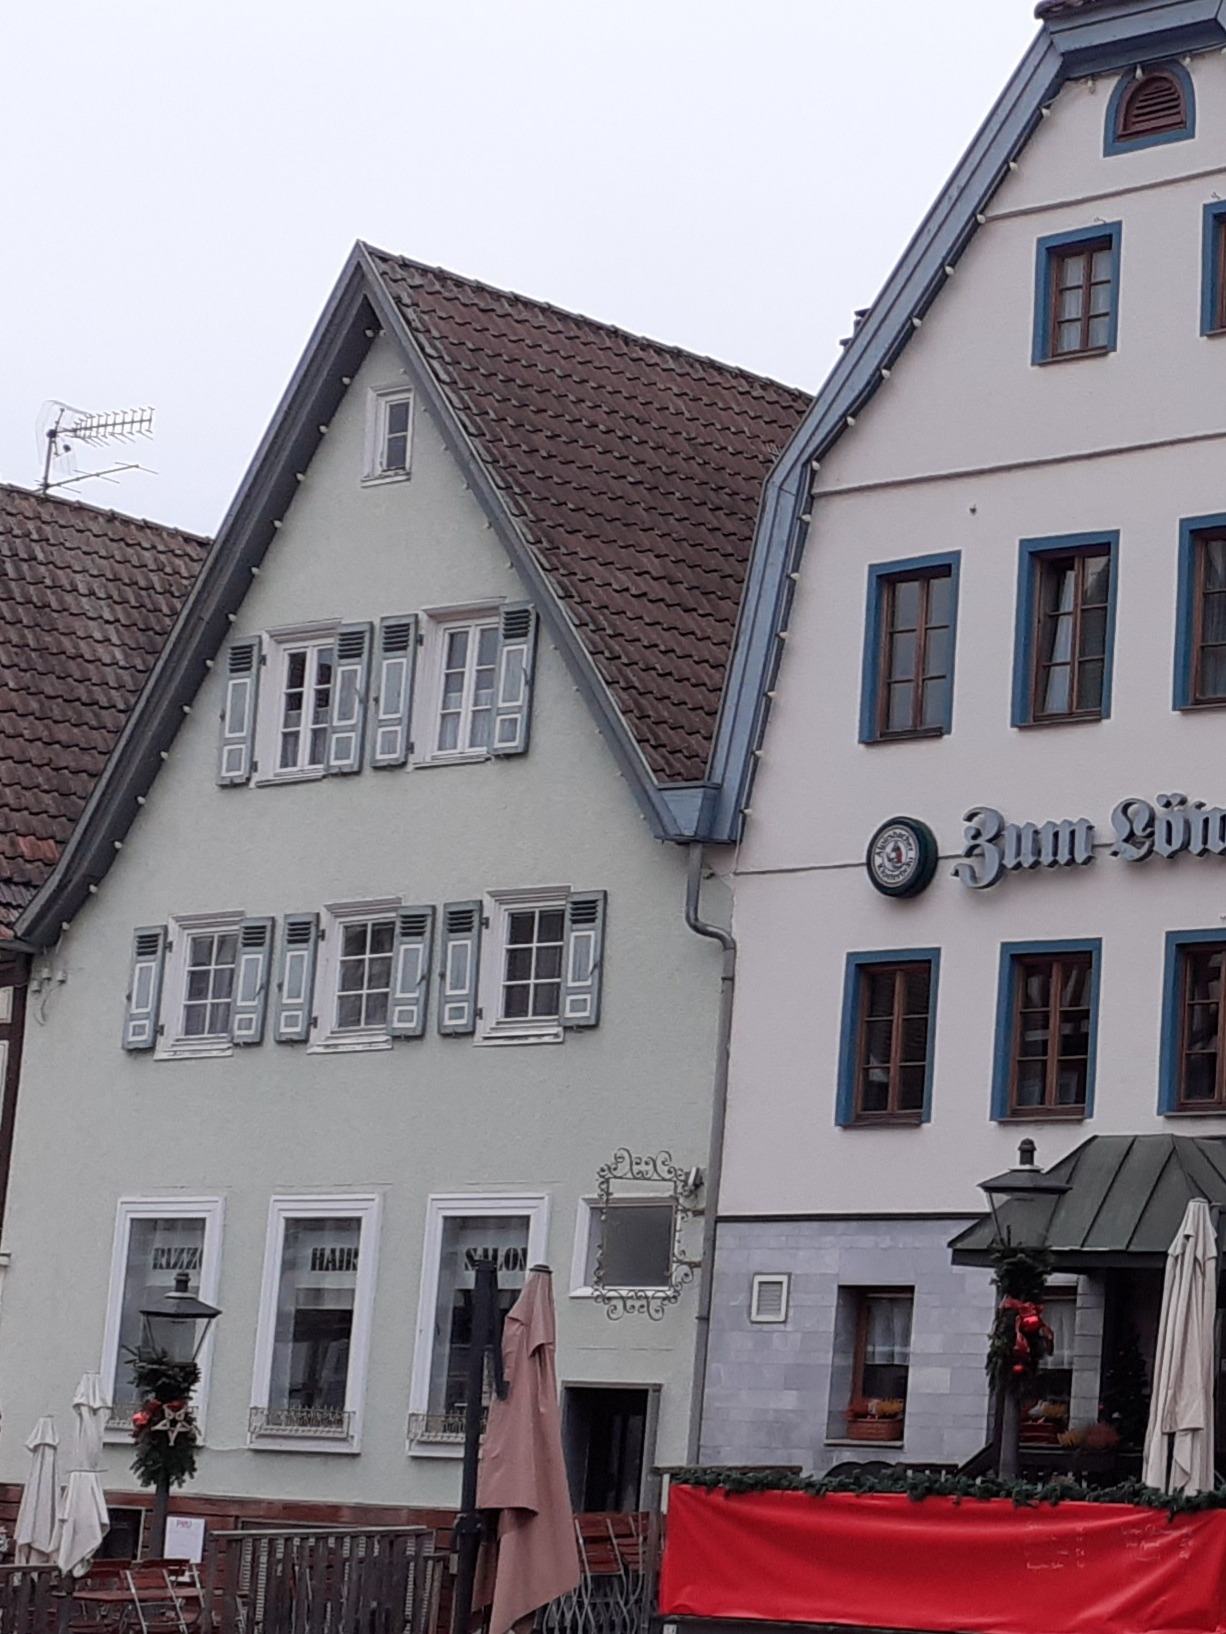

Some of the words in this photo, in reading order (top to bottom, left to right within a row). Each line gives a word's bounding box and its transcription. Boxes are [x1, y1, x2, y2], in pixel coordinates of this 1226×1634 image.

[951, 806, 1095, 889] Zum
[152, 1247, 204, 1270] RIZZ
[310, 1247, 359, 1272] HAIR
